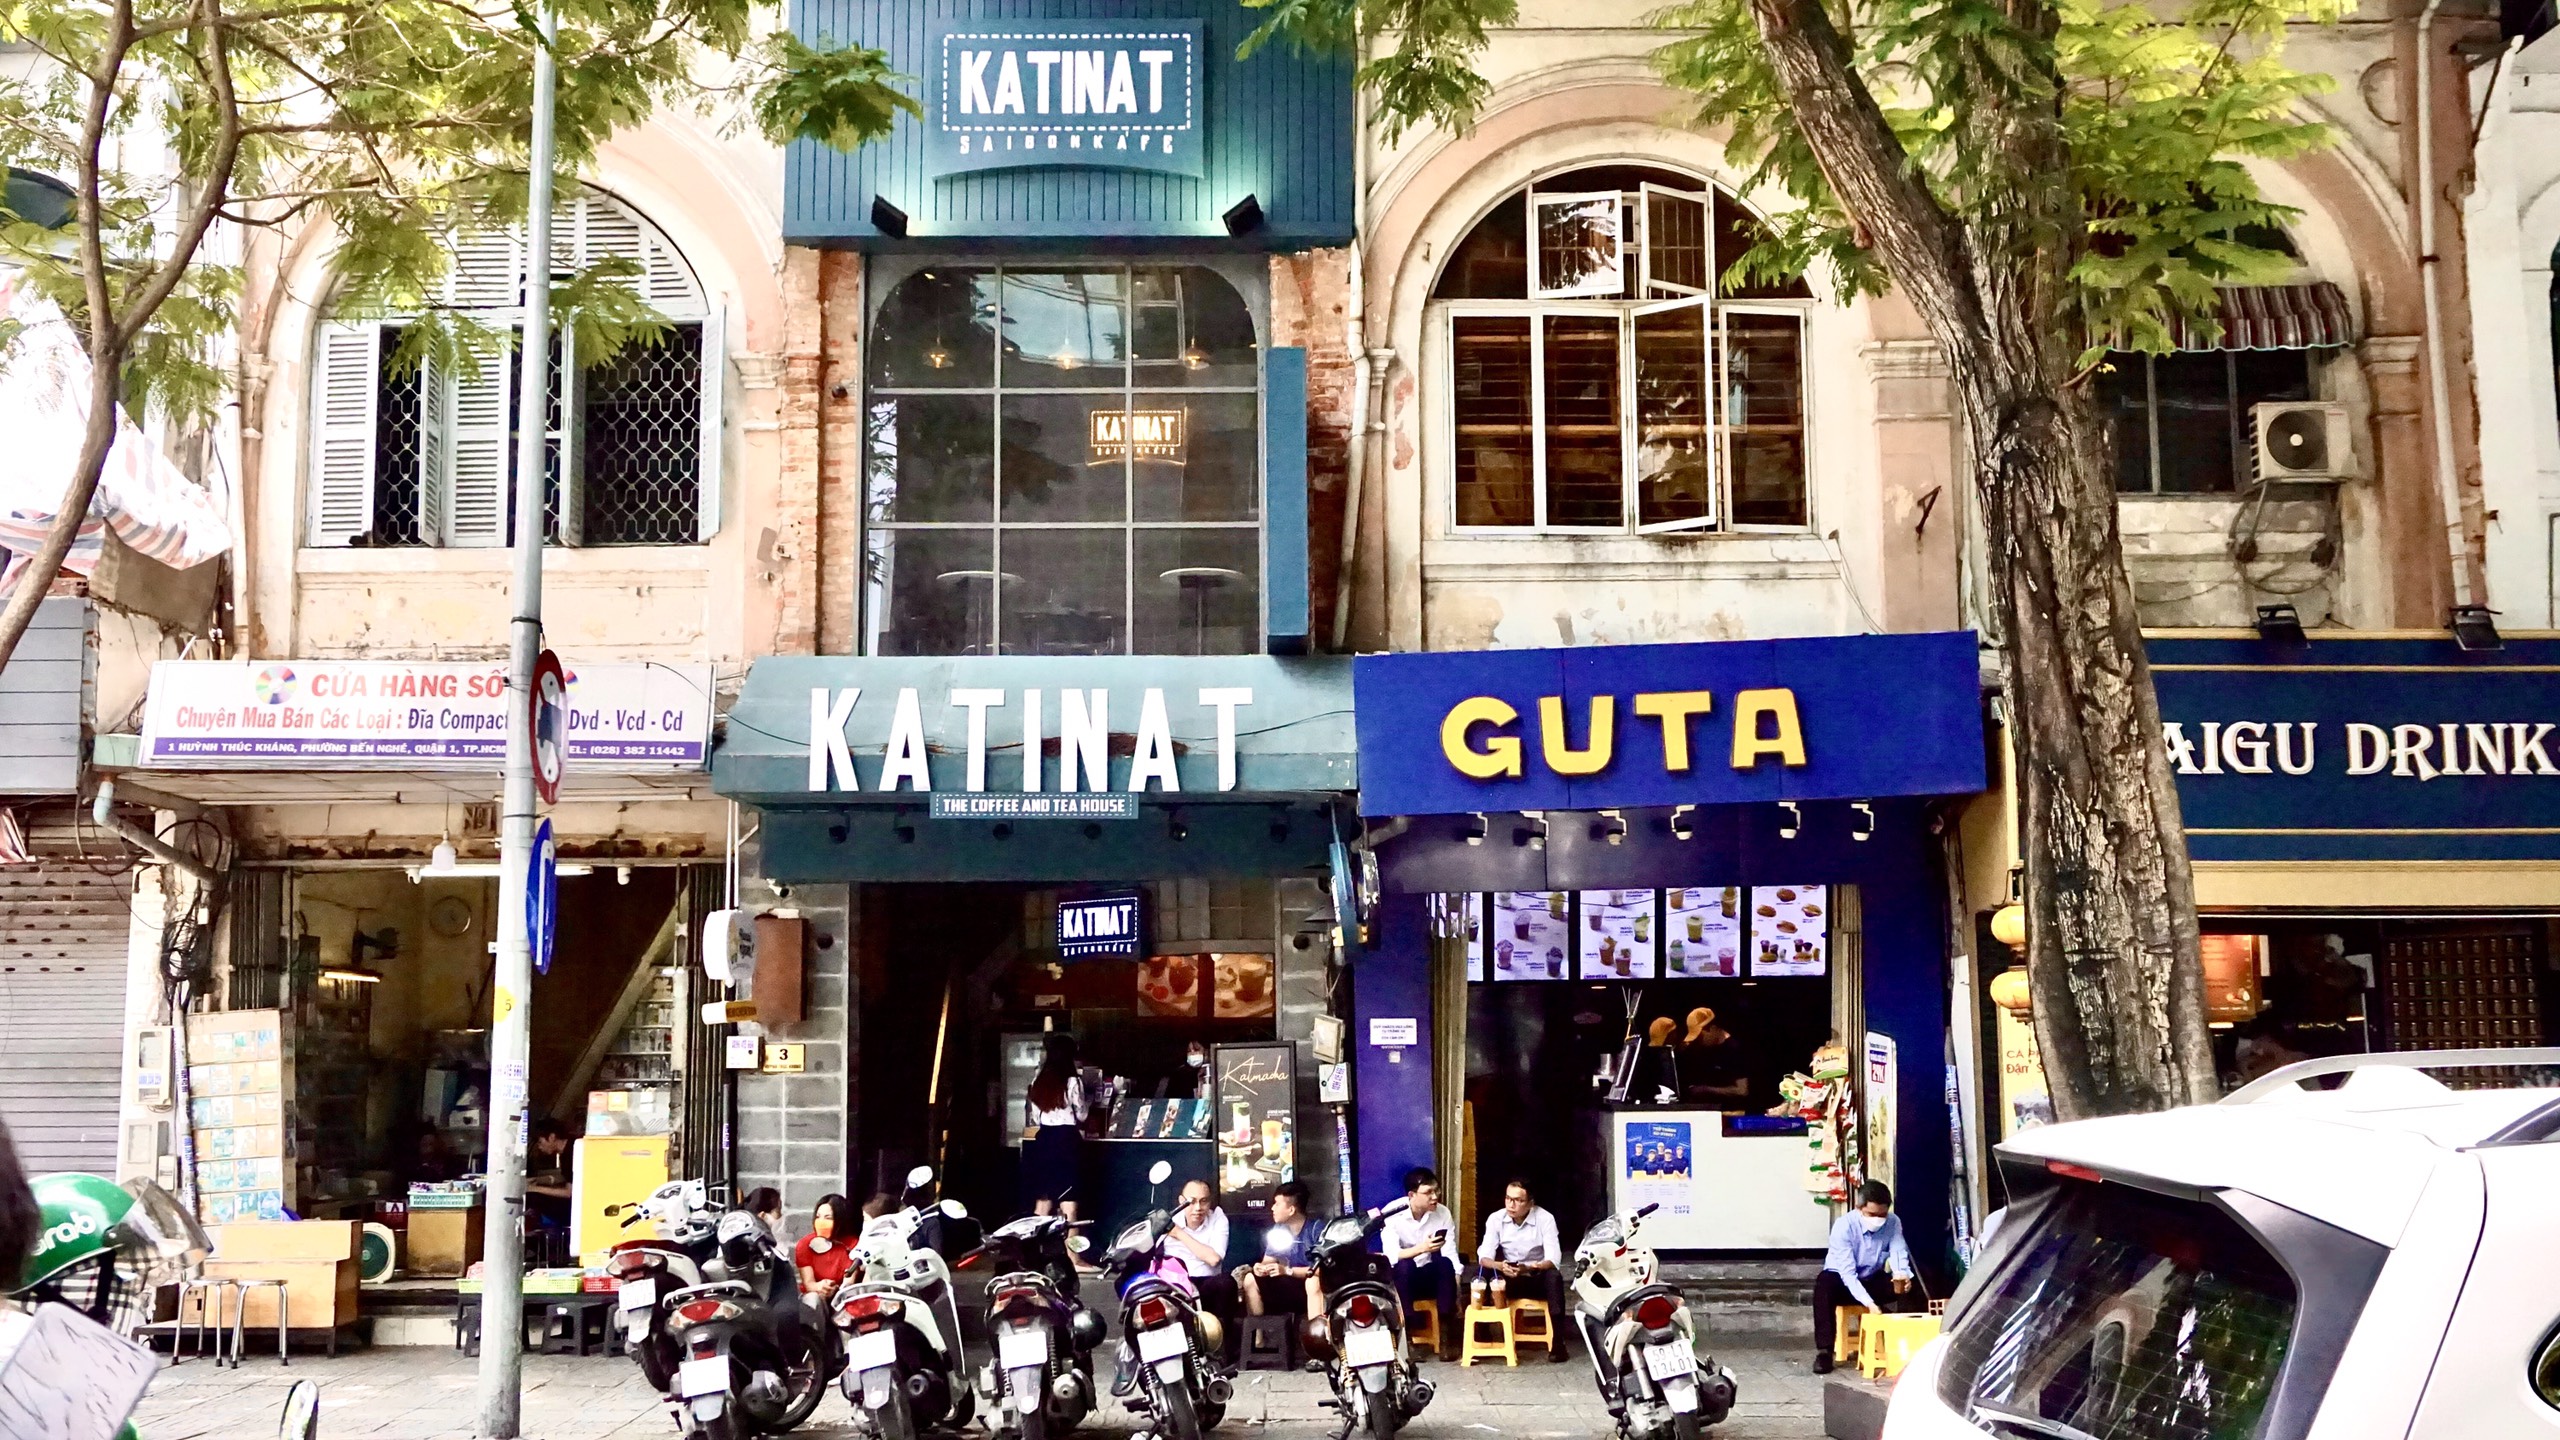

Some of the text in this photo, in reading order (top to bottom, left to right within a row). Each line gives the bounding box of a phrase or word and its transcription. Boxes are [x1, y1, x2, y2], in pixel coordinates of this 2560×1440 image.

[959, 49, 1174, 115] KATINAT
[379, 669, 458, 698] HÀNG
[176, 706, 236, 732] Chuyên
[242, 706, 276, 729] Mua
[282, 706, 314, 729] Bán
[320, 707, 350, 729] Các
[356, 709, 392, 734] Loại
[408, 708, 434, 730] Đĩa
[568, 709, 599, 731] Dvd
[616, 709, 646, 731] Vcd
[662, 710, 683, 732] Cd
[1440, 687, 1807, 778] GUTA
[167, 742, 175, 752] 1
[221, 740, 252, 752] THÚC
[255, 740, 297, 754] KHÁNG,
[568, 746, 587, 754] EL:
[590, 745, 620, 756] (028)
[623, 746, 646, 755] 382
[649, 746, 685, 756] 11442
[808, 687, 1253, 793] KATINAT
[2161, 720, 2319, 775] AIGU
[943, 798, 1126, 813] THE COFFEE AND TEA HOUSE
[1062, 904, 1132, 938] KATINAT
[778, 1048, 789, 1061] 3
[31, 1211, 97, 1257] rab
